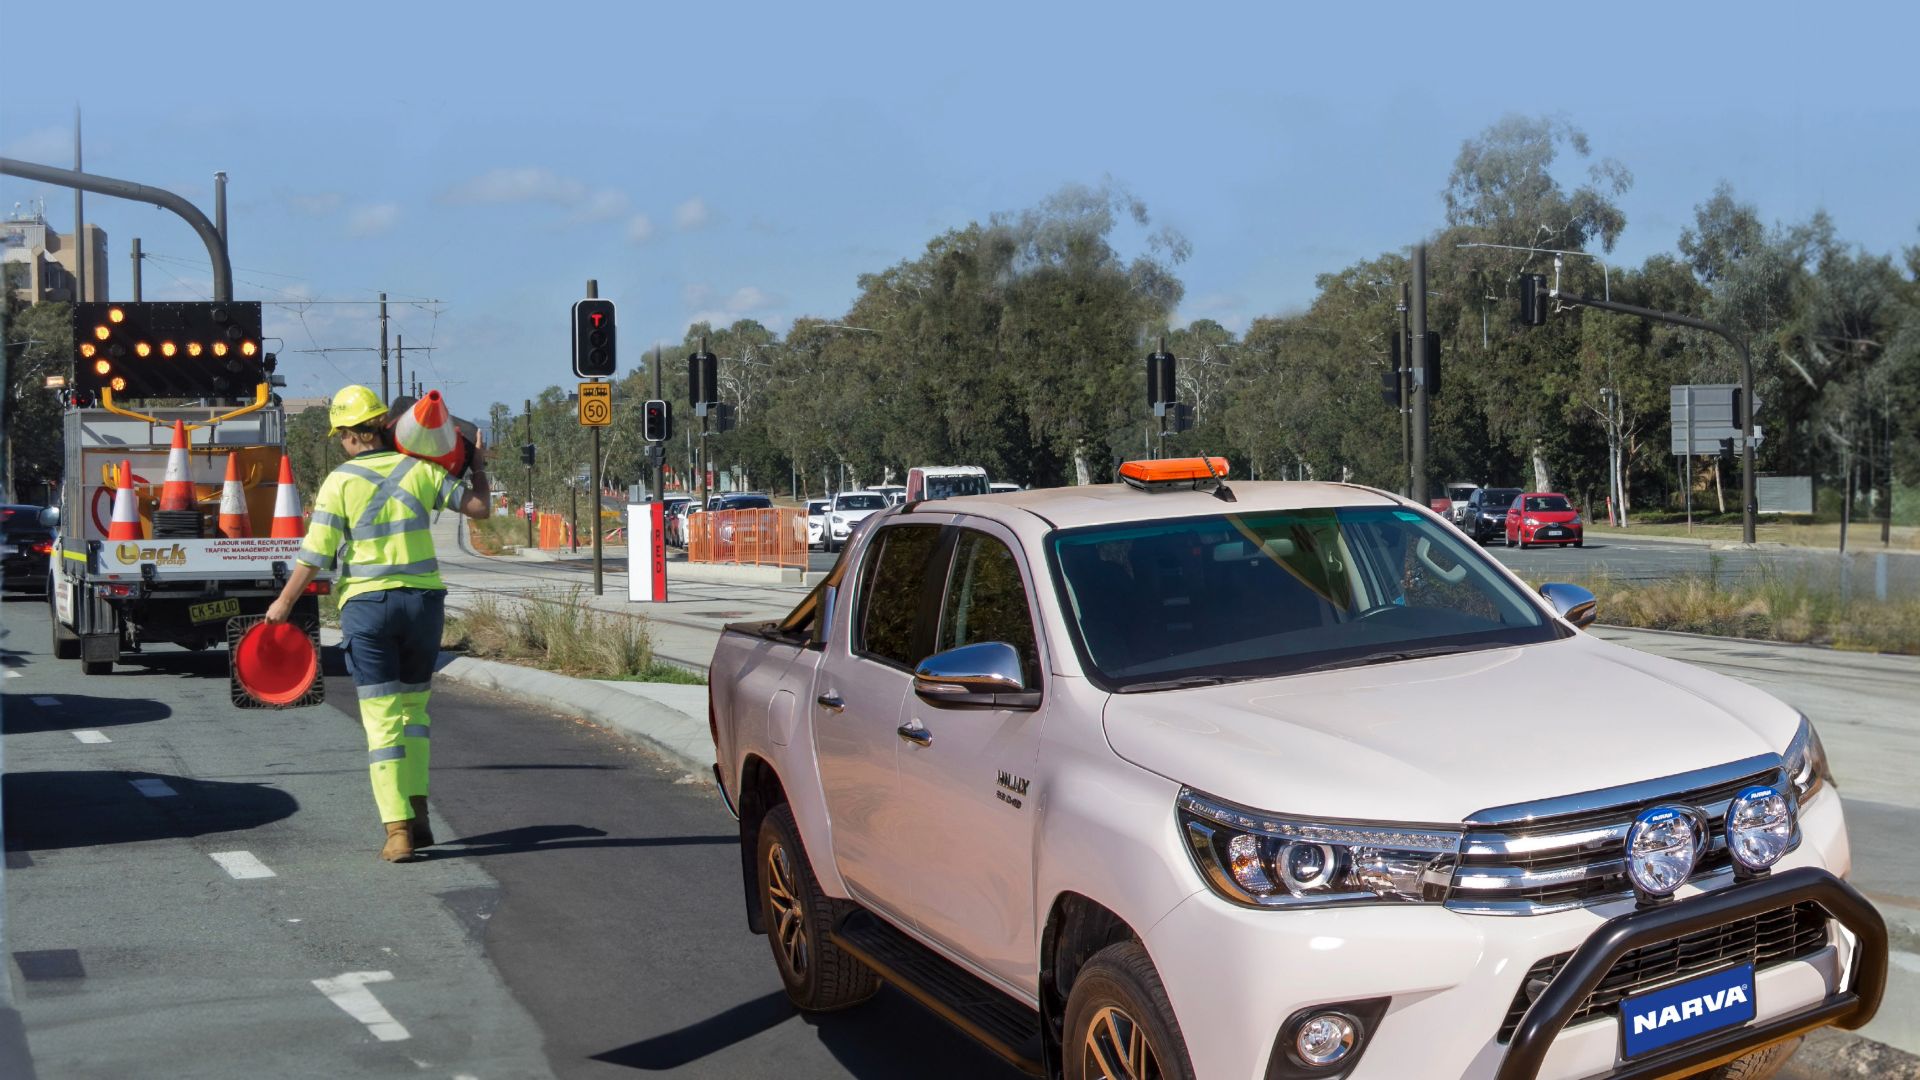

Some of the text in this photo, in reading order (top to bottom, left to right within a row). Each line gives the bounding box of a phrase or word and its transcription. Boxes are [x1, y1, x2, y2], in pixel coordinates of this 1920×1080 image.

[588, 404, 604, 418] 50
[116, 543, 188, 565] Lack
[156, 558, 187, 567] group
[191, 606, 206, 618] CK
